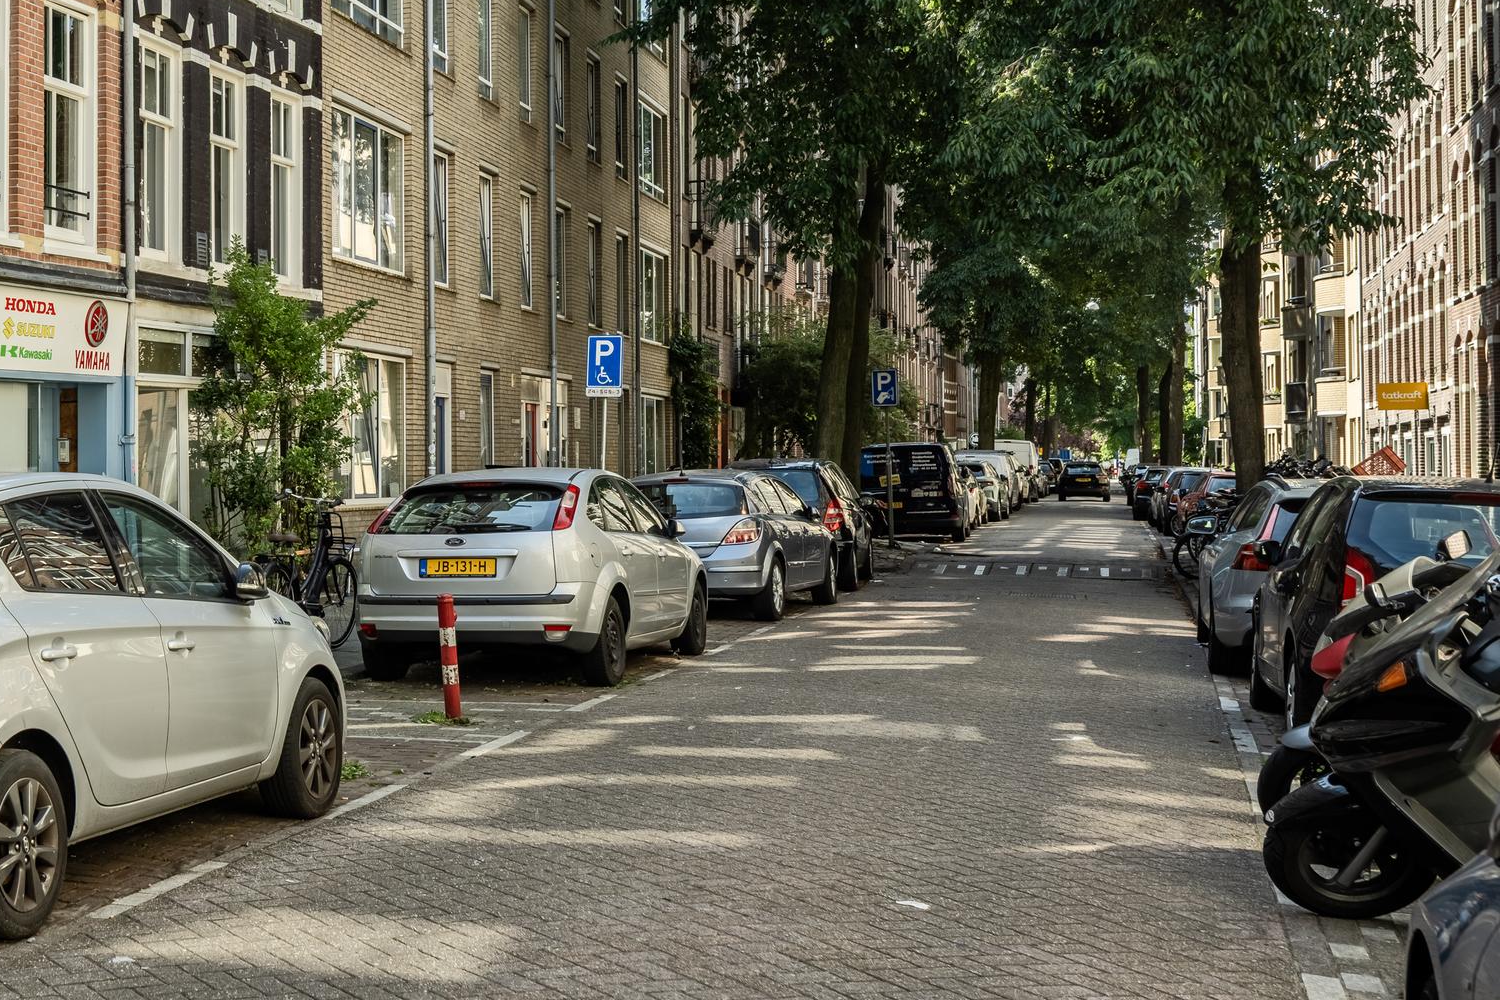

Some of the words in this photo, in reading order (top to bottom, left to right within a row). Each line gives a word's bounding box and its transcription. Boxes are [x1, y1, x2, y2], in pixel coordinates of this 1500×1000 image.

[4, 297, 57, 315] HONDA
[16, 321, 56, 339] SUZUKI
[19, 346, 53, 361] Kawasaki
[75, 349, 110, 371] YAMAHA
[596, 340, 614, 365] P
[877, 372, 891, 391] P
[1381, 391, 1422, 399] tatkraft
[434, 561, 487, 573] JB-131-H
